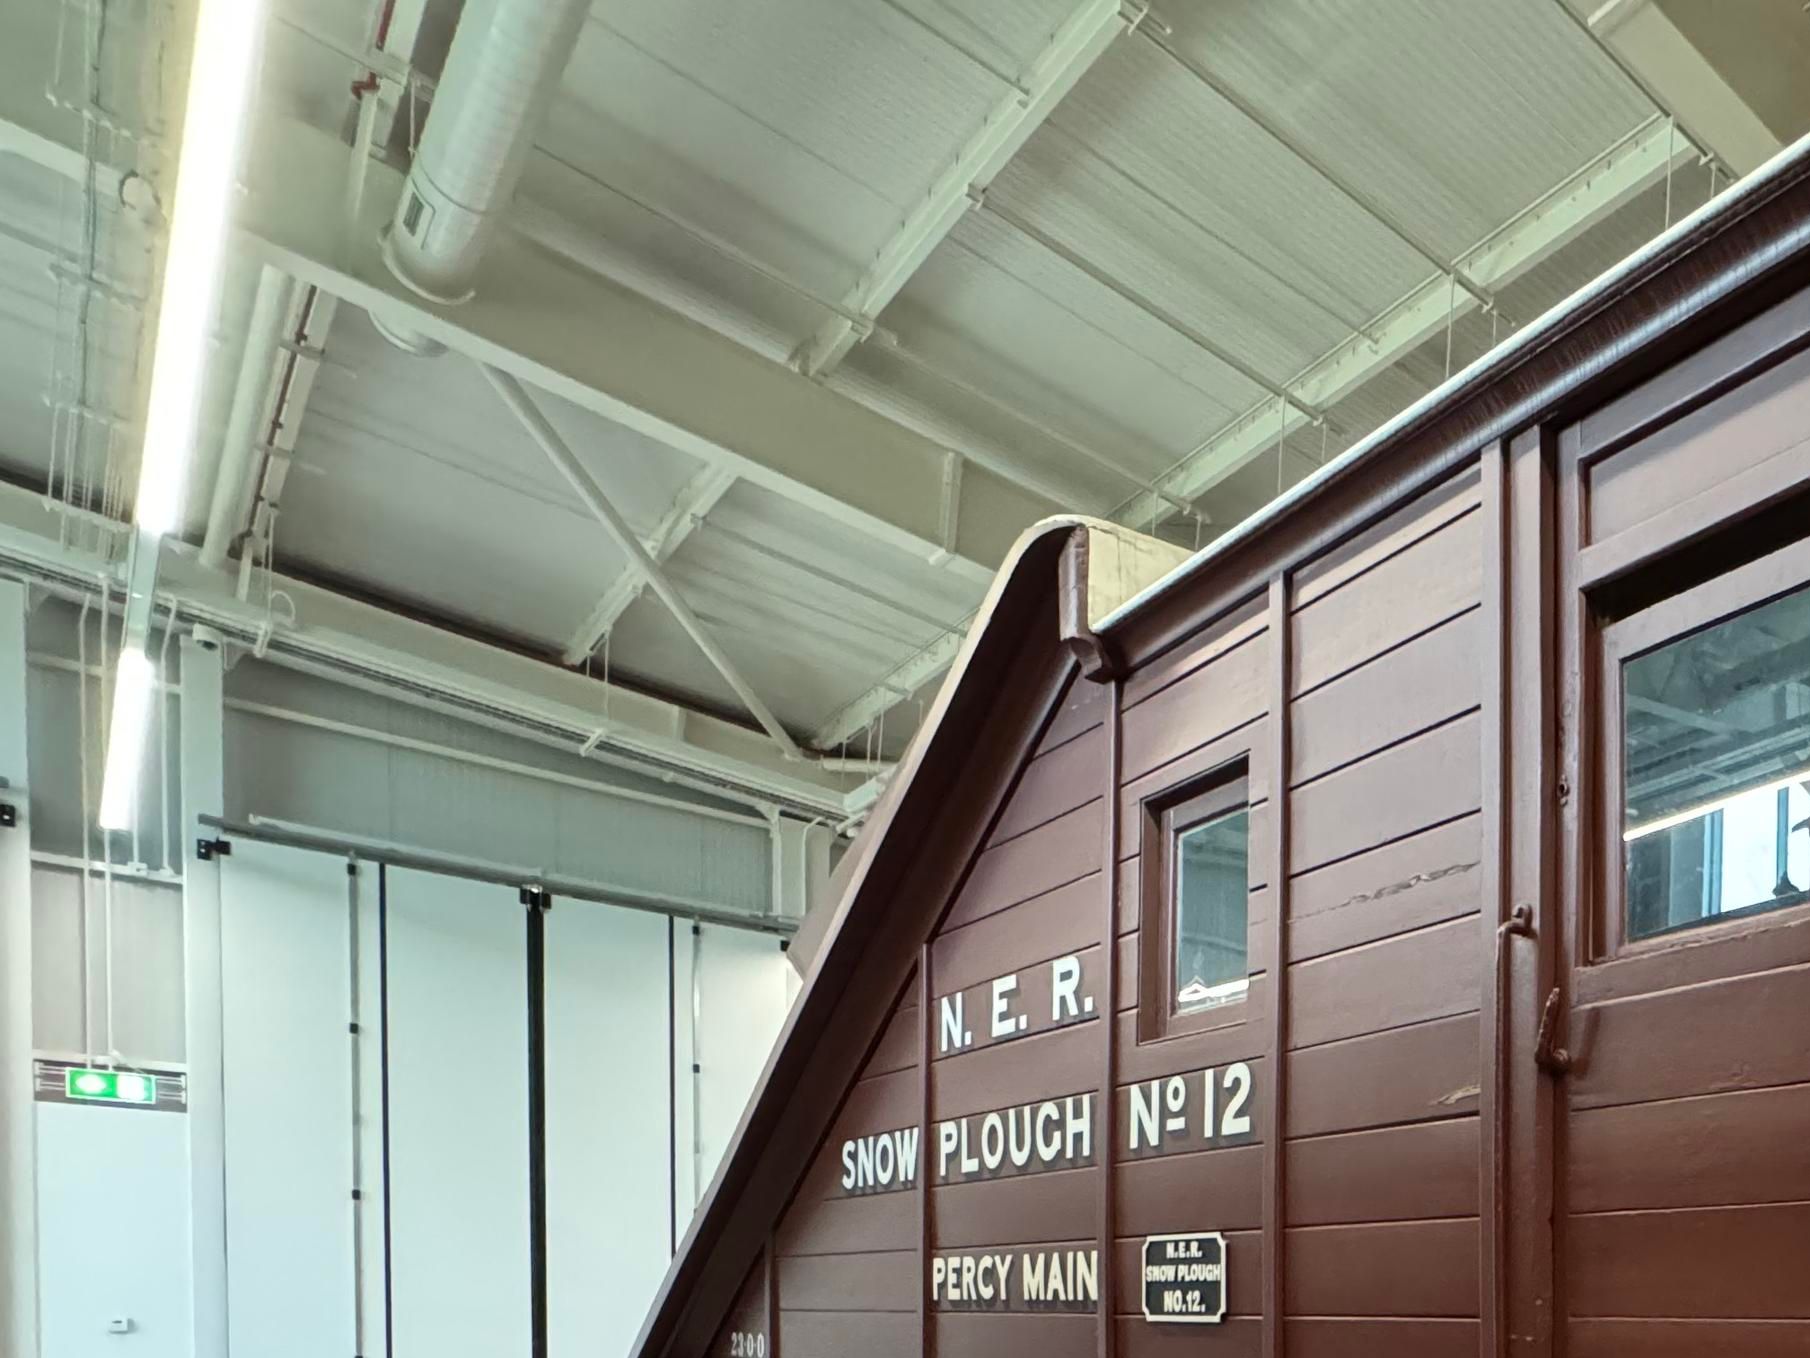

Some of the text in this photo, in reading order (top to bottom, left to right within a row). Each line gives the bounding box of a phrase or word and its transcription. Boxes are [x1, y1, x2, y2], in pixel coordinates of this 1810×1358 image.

[841, 1127, 919, 1190] SNOW
[939, 1095, 1091, 1176] PLOUGH
[1204, 1062, 1251, 1138] 12
[932, 1250, 1099, 1301] PERCY MAIN
[1146, 1264, 1221, 1283] SNOW PLOUGH
